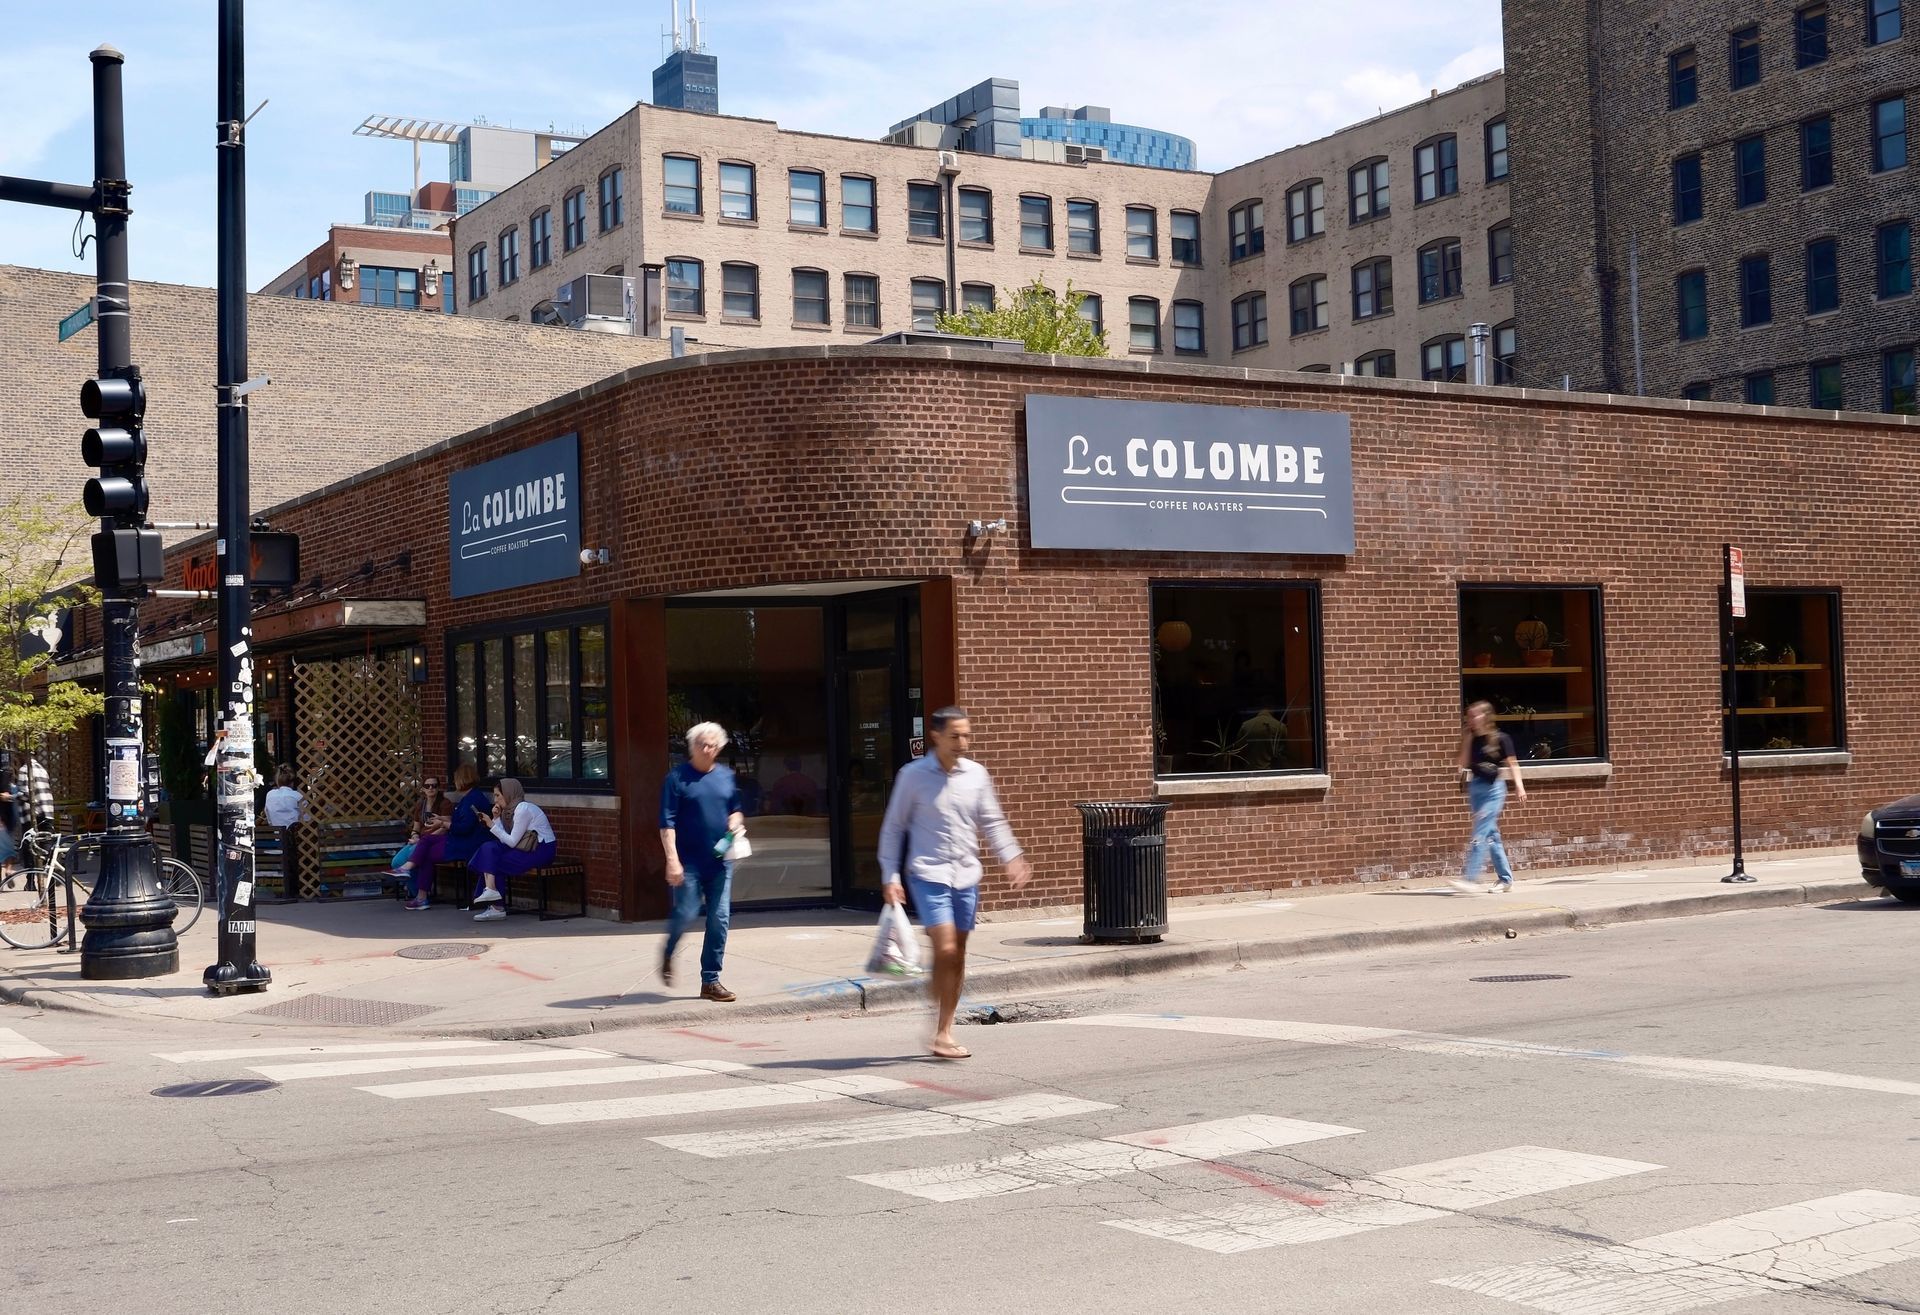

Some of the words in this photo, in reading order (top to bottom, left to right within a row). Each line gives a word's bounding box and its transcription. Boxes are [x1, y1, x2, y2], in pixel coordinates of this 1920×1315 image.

[1062, 435, 1117, 476] La
[1126, 438, 1325, 484] COLOMBE
[461, 500, 481, 535] La
[482, 472, 567, 529] COLOMBE
[1149, 500, 1188, 511] COFFEE
[1192, 501, 1243, 513] ROASTERS
[490, 542, 507, 555] COFFEE
[508, 538, 529, 552] ROASTERS
[183, 553, 217, 590] Nand
